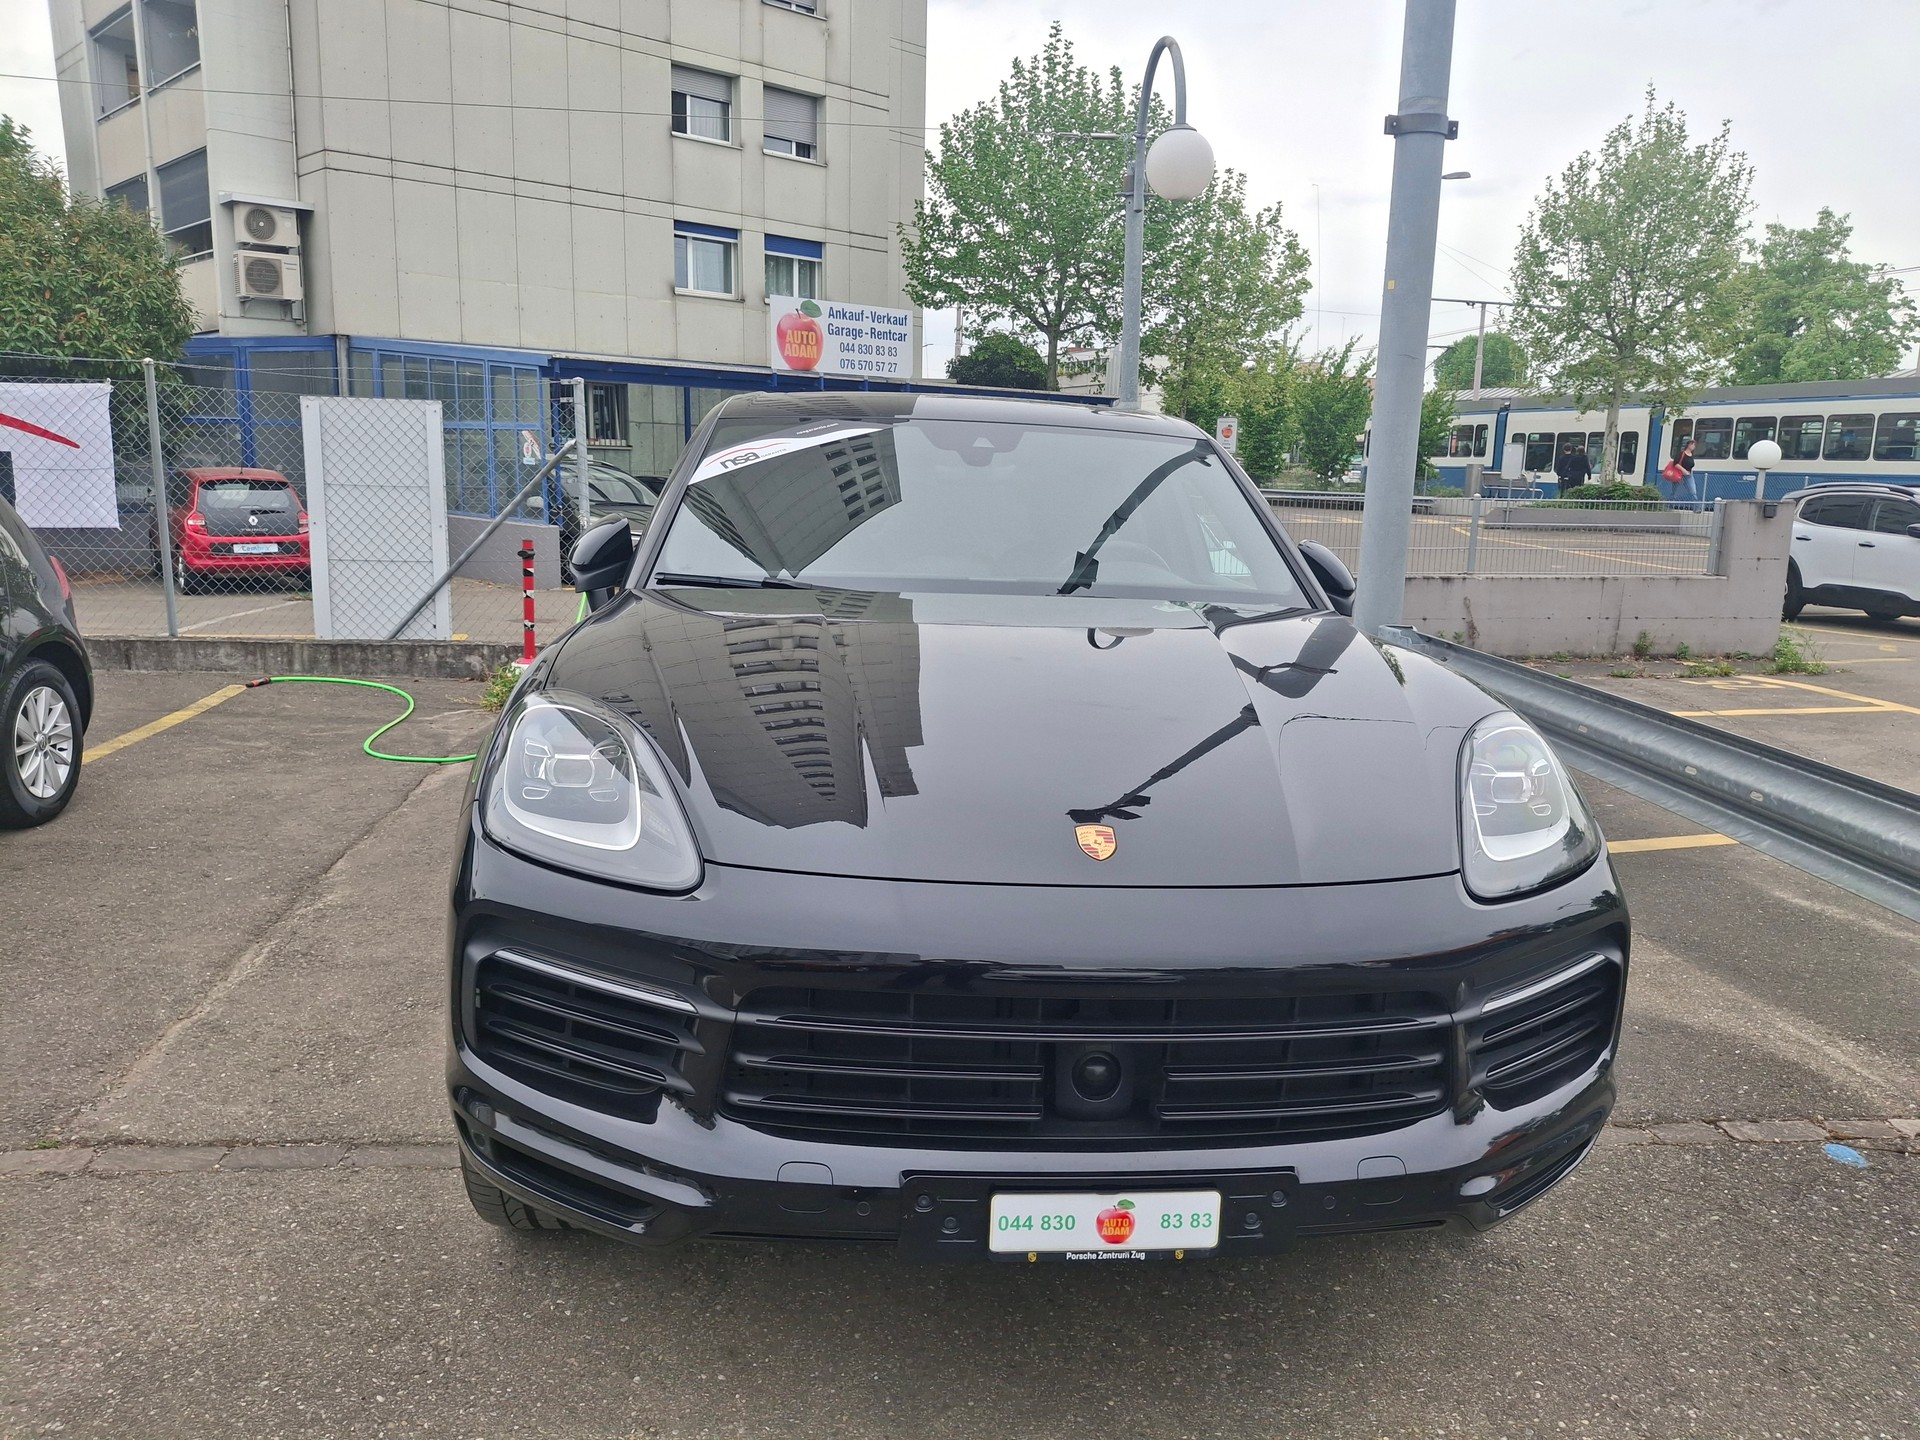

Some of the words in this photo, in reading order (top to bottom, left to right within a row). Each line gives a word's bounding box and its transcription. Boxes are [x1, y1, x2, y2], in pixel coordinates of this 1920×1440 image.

[786, 329, 817, 345] AUTO
[784, 344, 817, 359] ADAM
[839, 342, 855, 354] 044
[857, 343, 873, 355] 830
[875, 345, 885, 356] 83
[887, 346, 898, 357] 83
[839, 358, 856, 370] 076
[857, 359, 873, 372] 570
[875, 361, 885, 372] 57
[887, 362, 898, 373] 27
[719, 451, 761, 469] nsa
[998, 1215, 1034, 1231] 044
[1040, 1214, 1076, 1230] 830
[1160, 1213, 1183, 1229] 83
[1190, 1212, 1213, 1228] 83
[1103, 1218, 1130, 1227] AUTO
[1101, 1227, 1130, 1236] ADAM
[1066, 1251, 1098, 1261] Porsche
[1098, 1251, 1130, 1260] Zentrum
[1131, 1250, 1146, 1261] Zug
